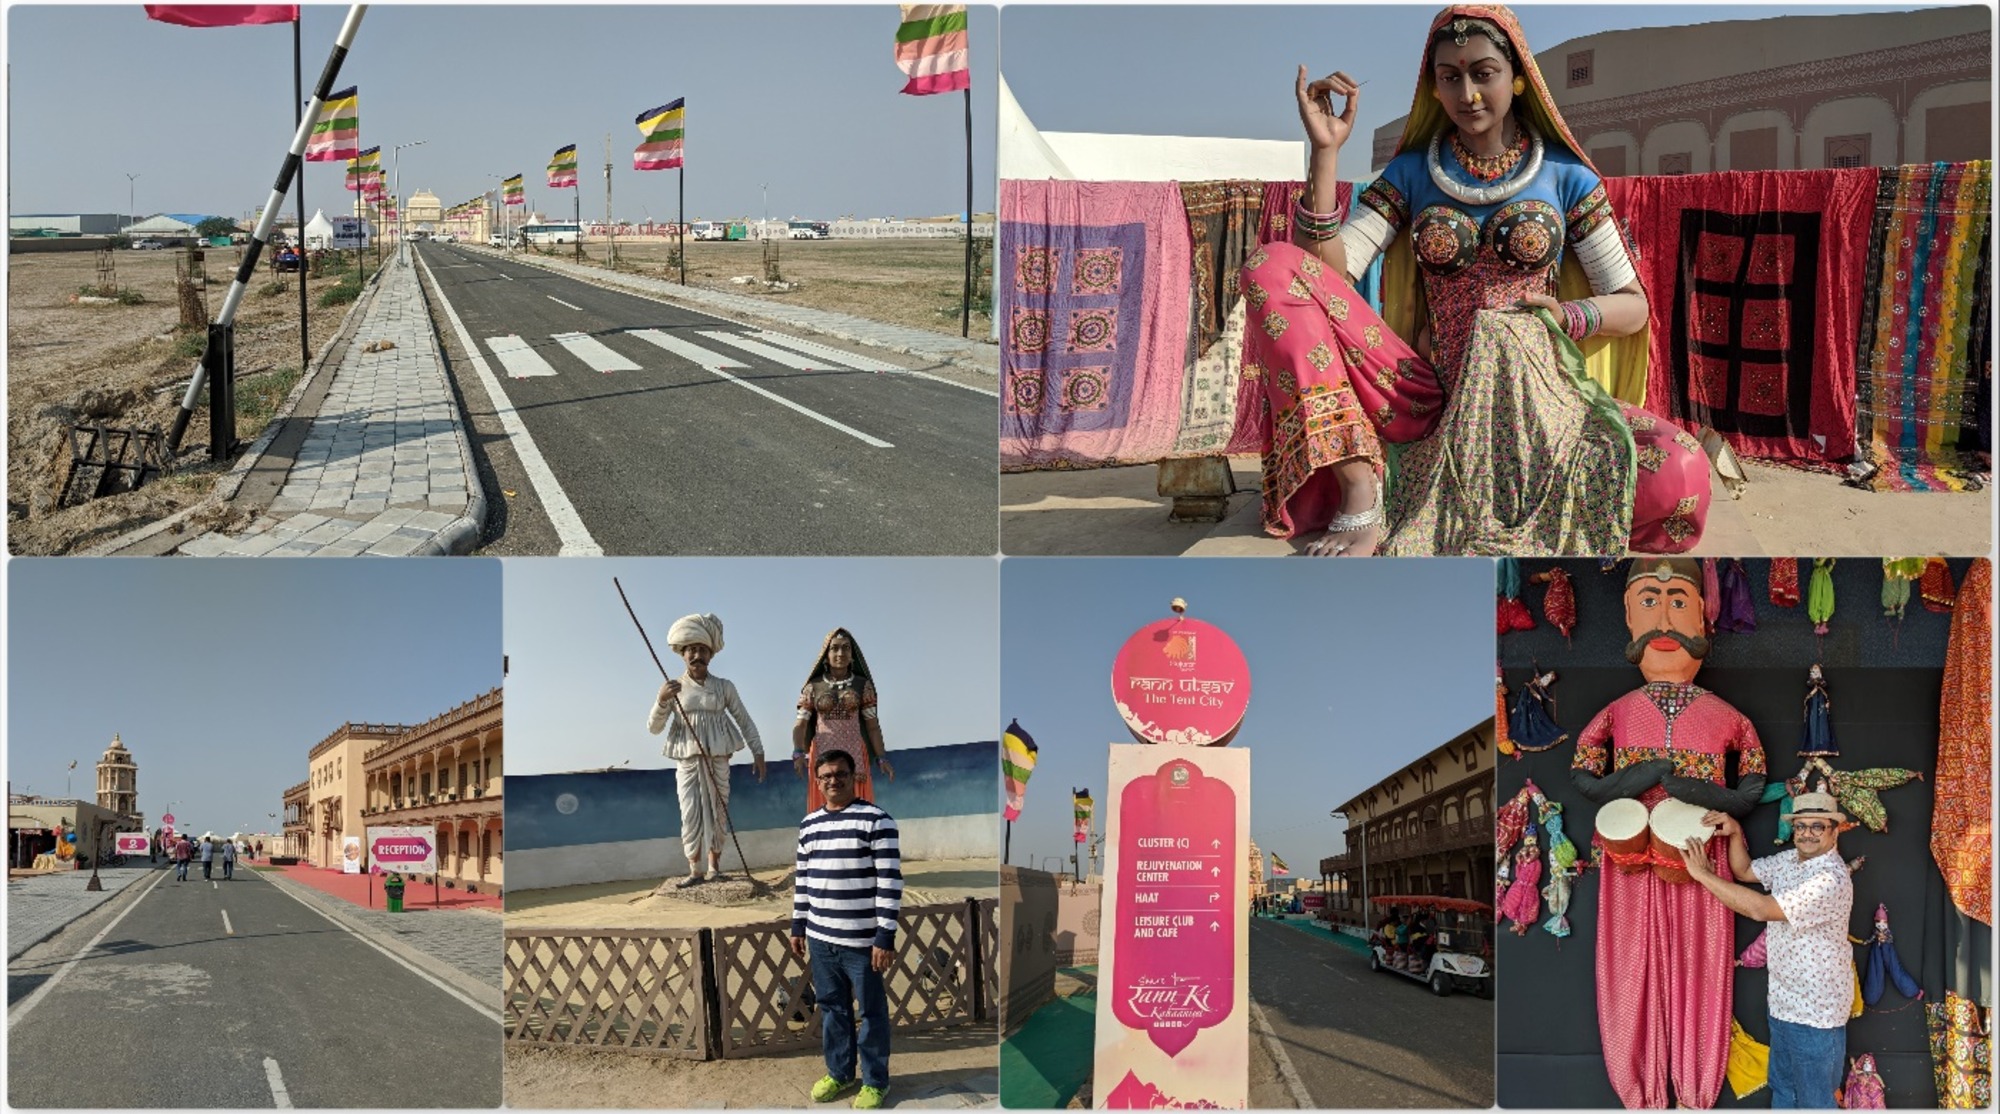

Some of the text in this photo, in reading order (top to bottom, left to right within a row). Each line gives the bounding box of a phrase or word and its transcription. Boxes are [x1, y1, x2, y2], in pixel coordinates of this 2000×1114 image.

[1144, 694, 1223, 709] The Tent City
[1138, 838, 1189, 849] CLUSTER (C)
[378, 845, 425, 855] RECEPTION
[1136, 861, 1202, 871] REJUVENATION
[1136, 872, 1169, 882] CENTER
[1135, 893, 1159, 903] HAAT
[1135, 915, 1194, 927] LEISURE CLUB
[1134, 928, 1178, 938] AND CAFE
[1181, 985, 1211, 1012] Ki
